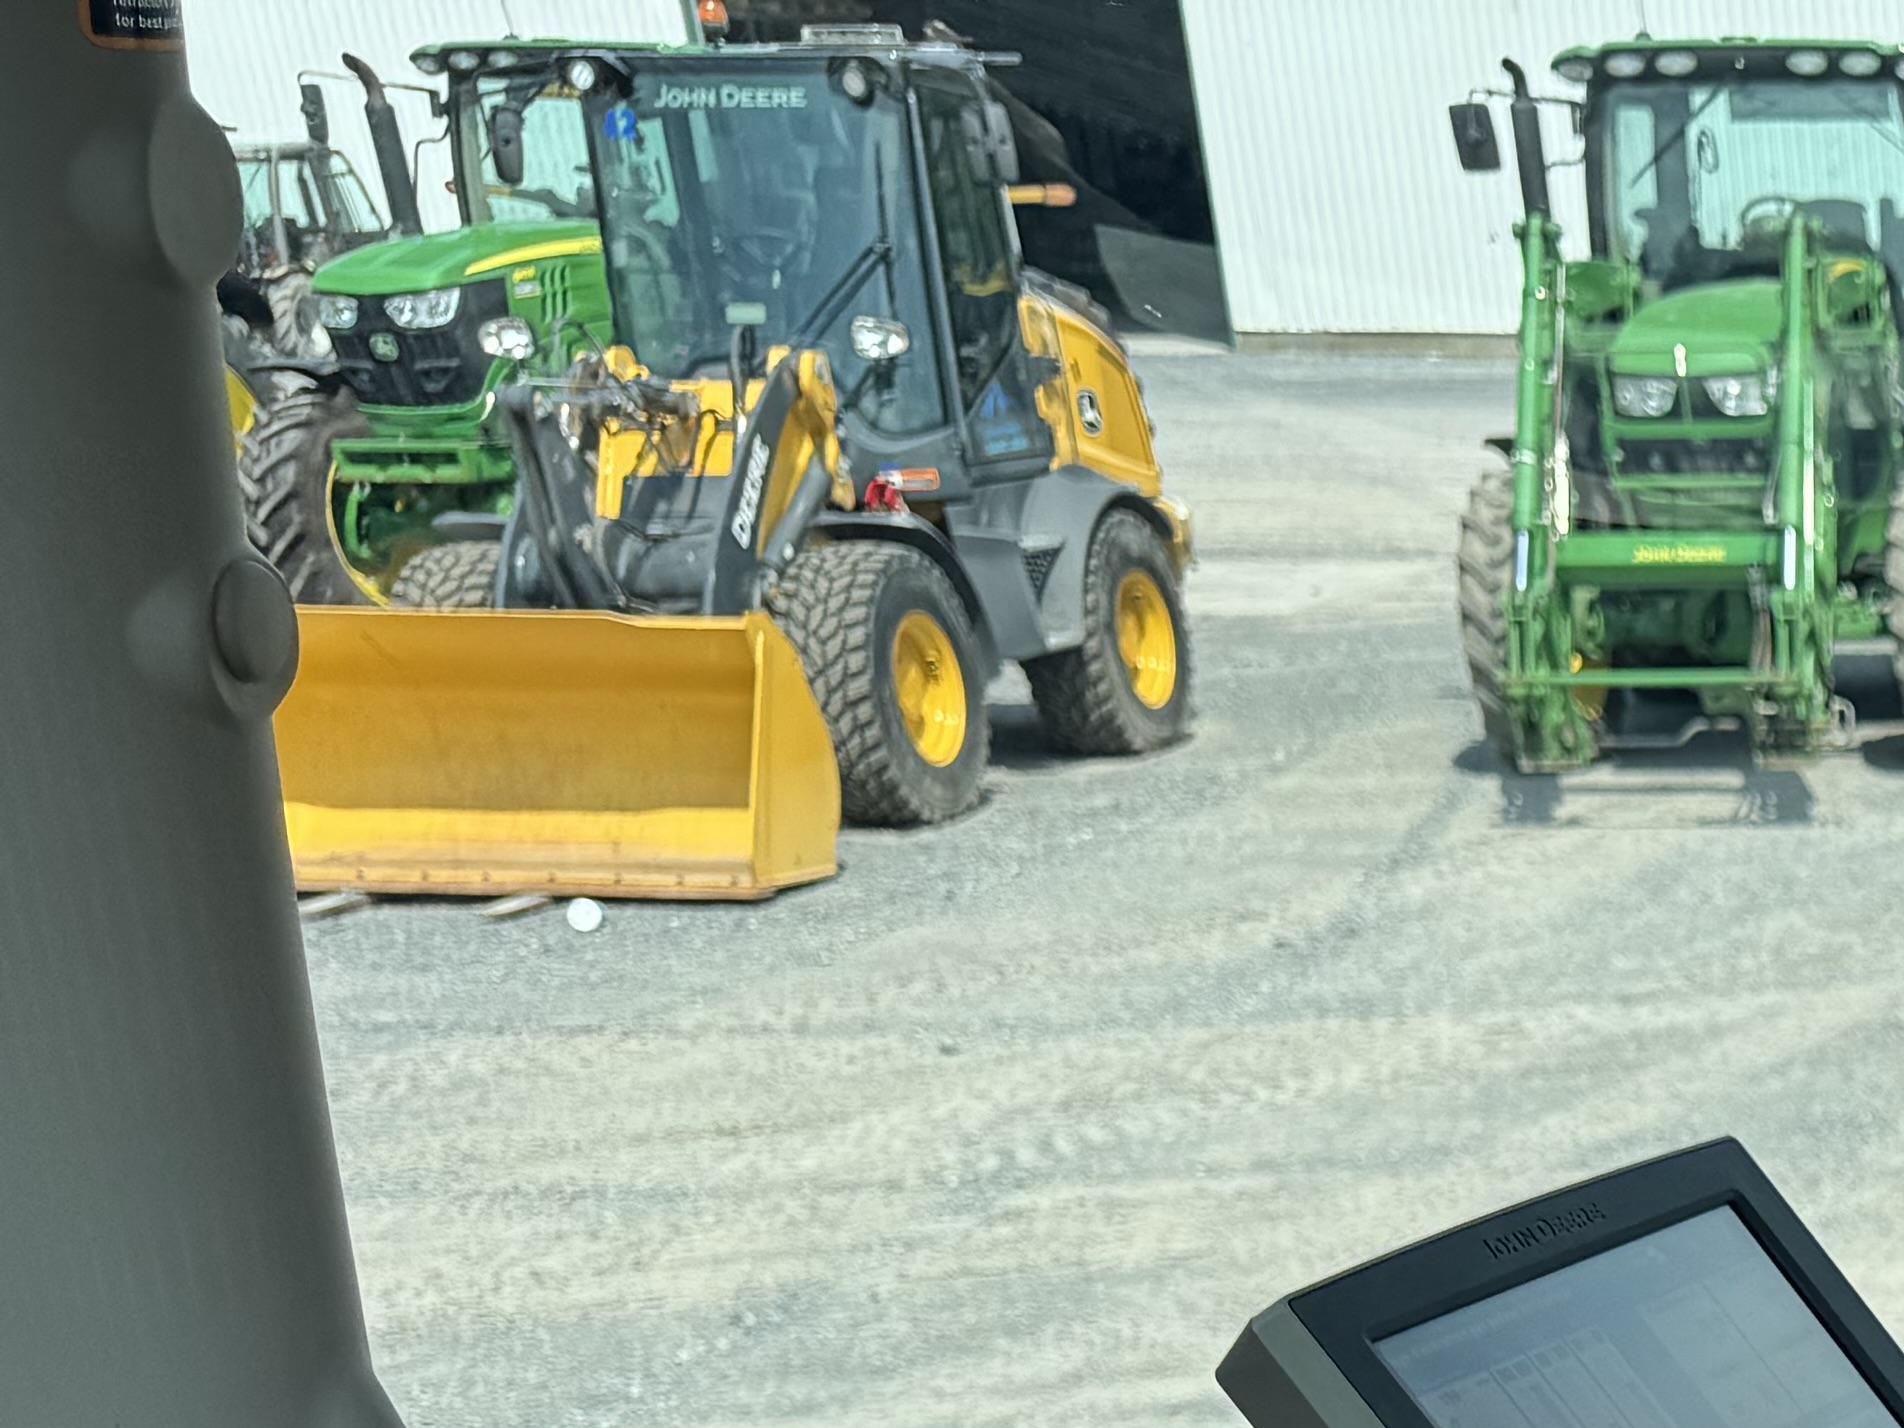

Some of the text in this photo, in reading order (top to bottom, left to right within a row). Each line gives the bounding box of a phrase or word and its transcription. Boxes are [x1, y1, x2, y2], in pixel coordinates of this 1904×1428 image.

[654, 83, 808, 108] JOHN DEERE
[731, 433, 769, 549] DEERE
[1482, 1203, 1606, 1259] JOHN DEERE
